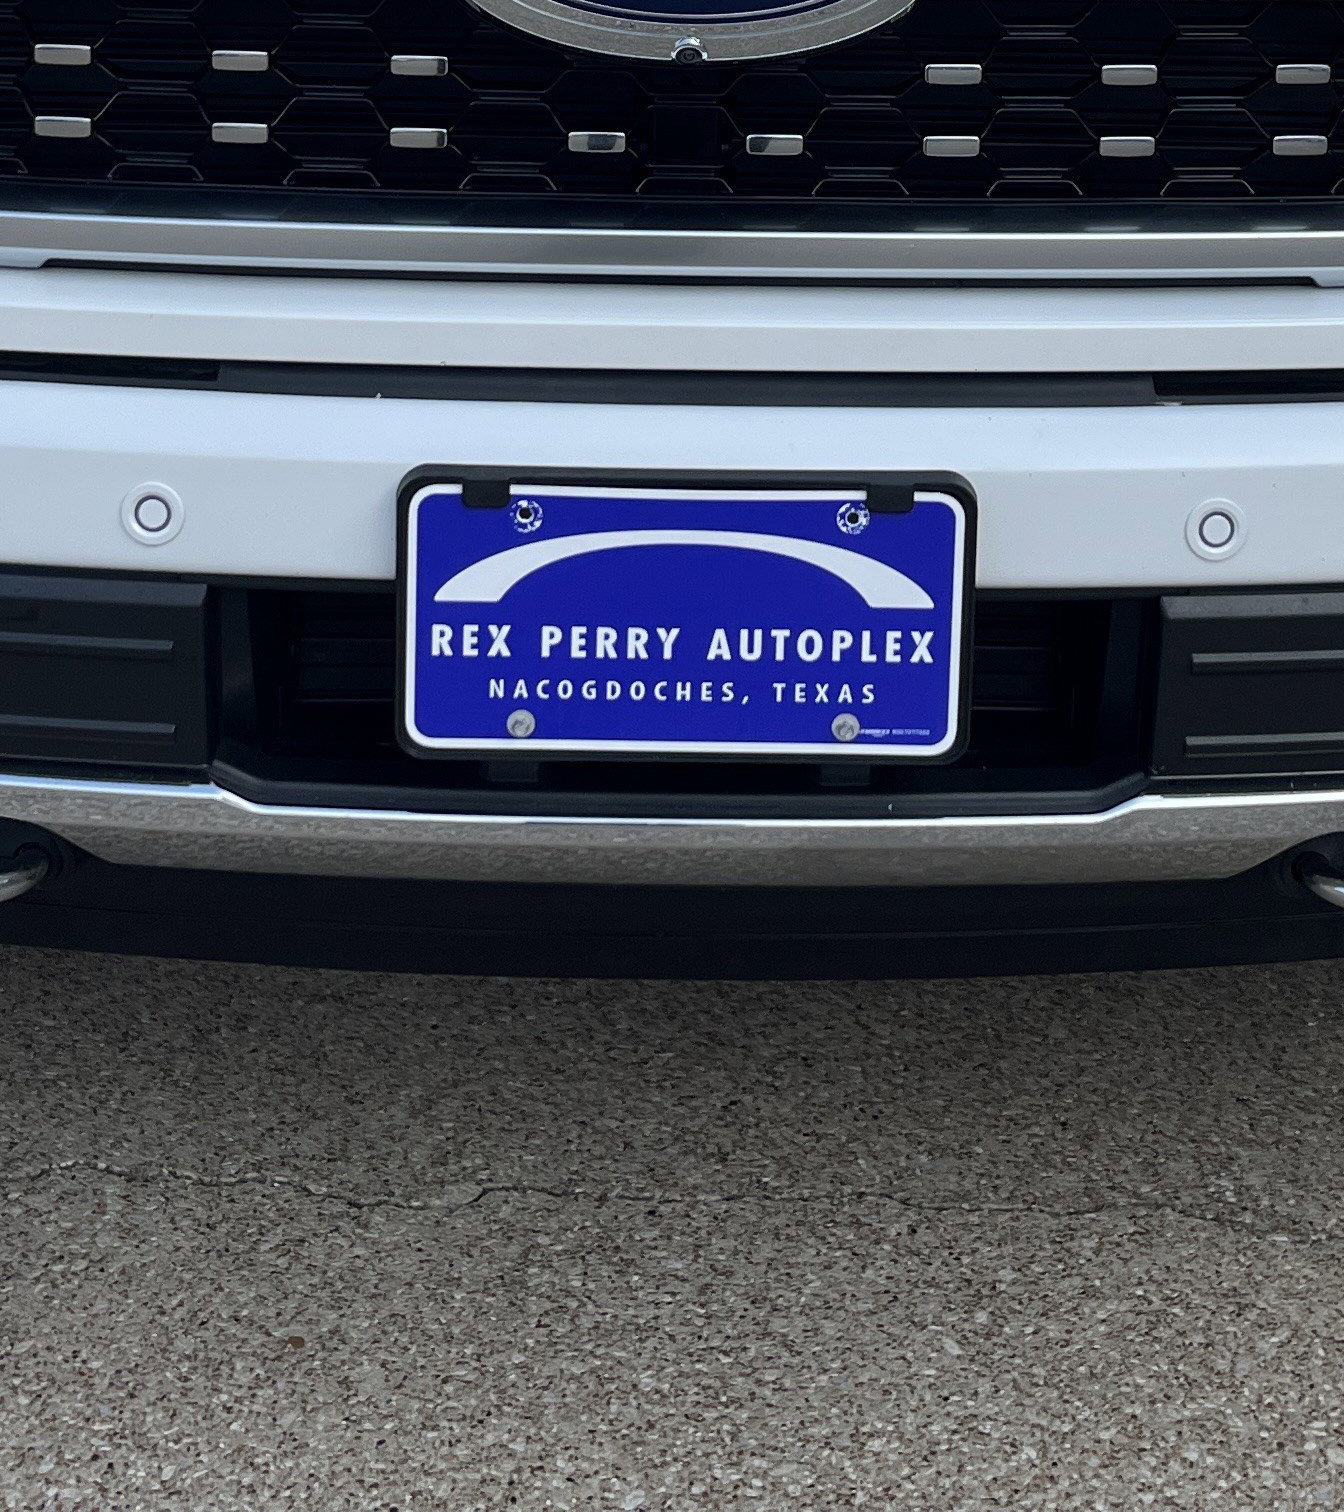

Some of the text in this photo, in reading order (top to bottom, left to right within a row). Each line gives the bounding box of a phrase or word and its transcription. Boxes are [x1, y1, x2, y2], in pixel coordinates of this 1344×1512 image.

[430, 623, 935, 664] REX PERRY AUTOPLEX
[488, 678, 876, 706] NACOGDOCHES, TEXAS
